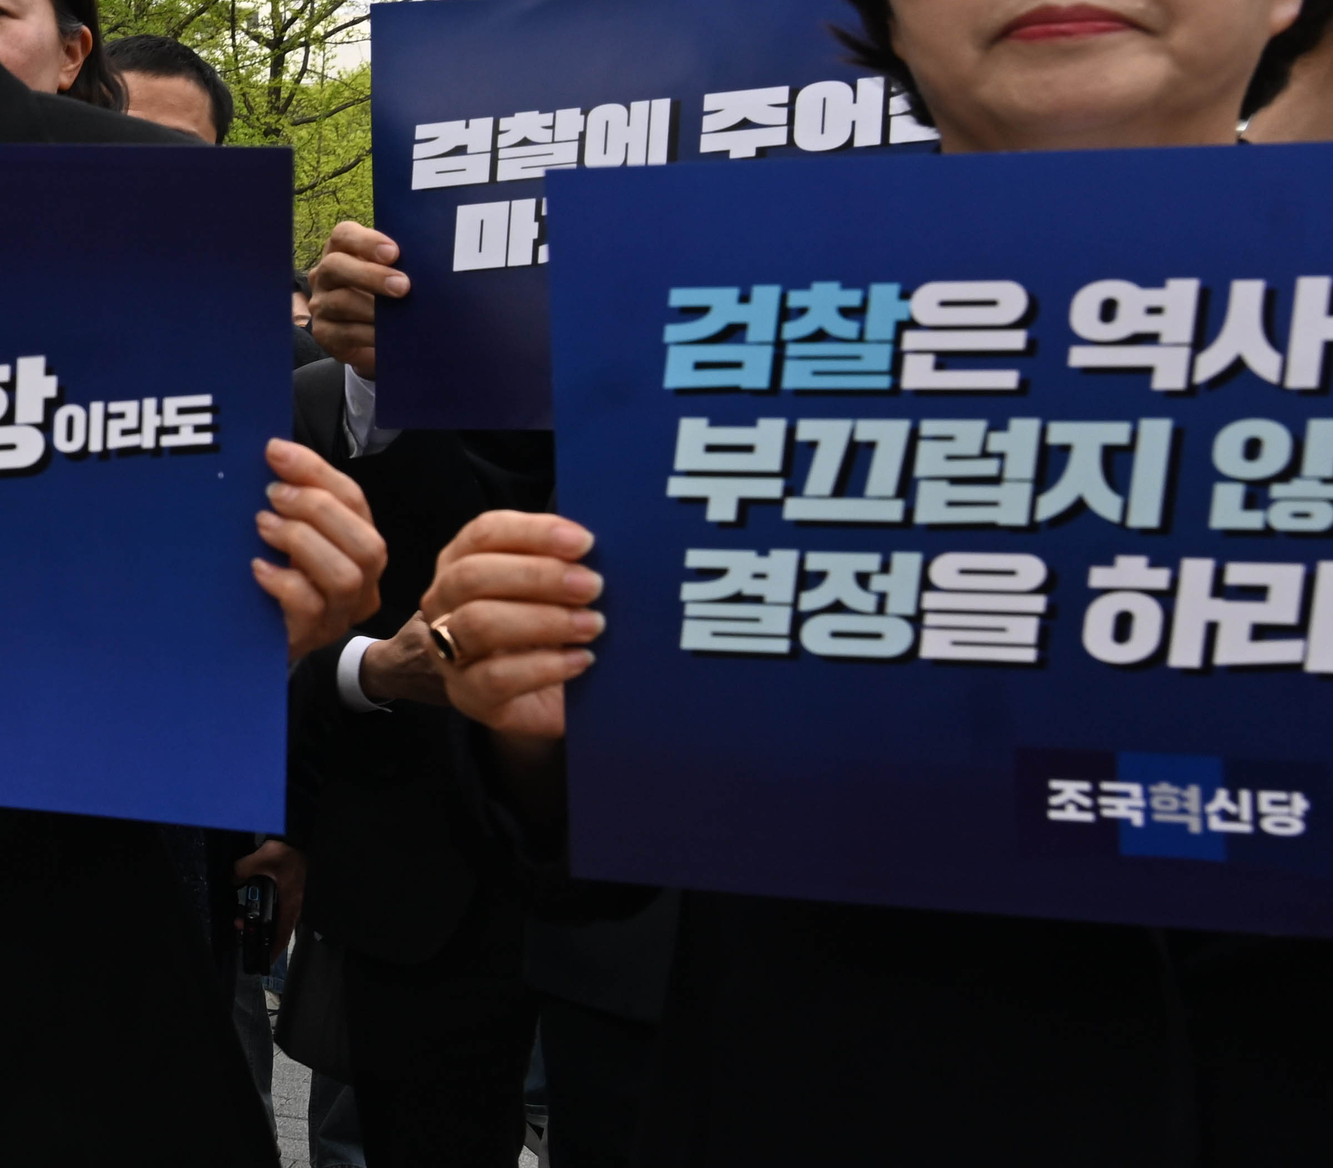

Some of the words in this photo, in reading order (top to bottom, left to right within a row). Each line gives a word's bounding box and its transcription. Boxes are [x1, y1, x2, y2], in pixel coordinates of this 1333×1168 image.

[411, 97, 671, 190] 검찰에
[663, 280, 1030, 390] 검찰은
[1068, 276, 1333, 391] 역사
[666, 418, 1174, 529] 부끄럽지
[679, 549, 1048, 664] 결정을
[1047, 779, 1310, 836] 조국혁신당
